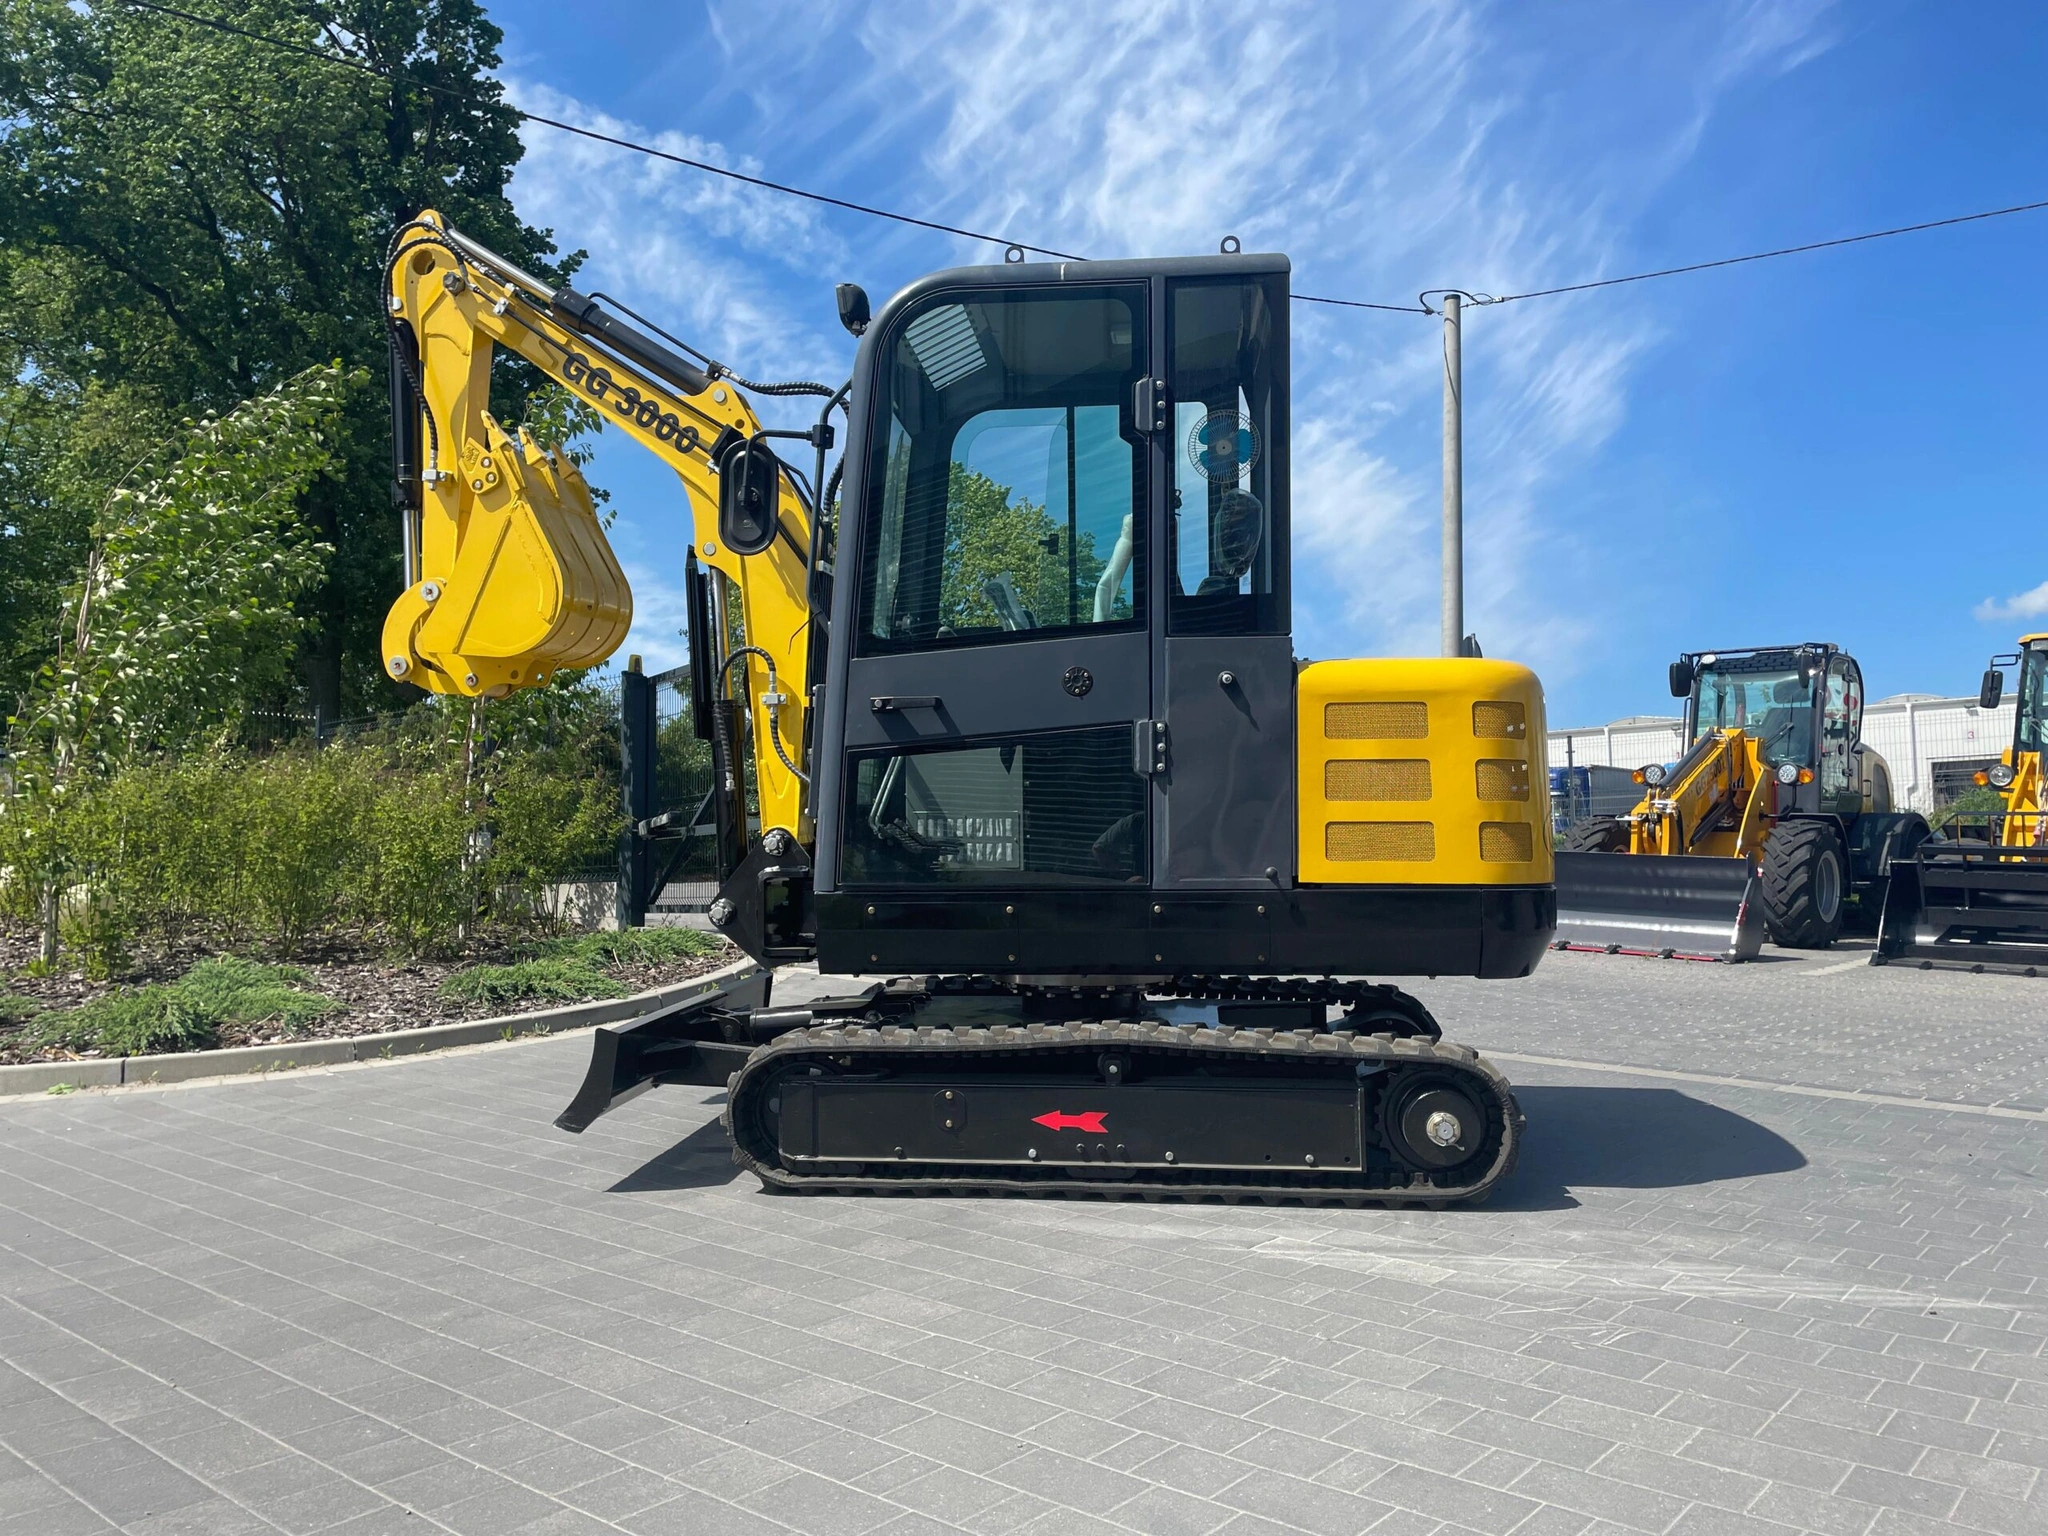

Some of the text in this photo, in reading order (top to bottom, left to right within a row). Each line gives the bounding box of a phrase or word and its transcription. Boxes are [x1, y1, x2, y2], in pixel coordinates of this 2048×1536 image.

[562, 352, 700, 454] GG 3000
[1966, 730, 1975, 740] 3
